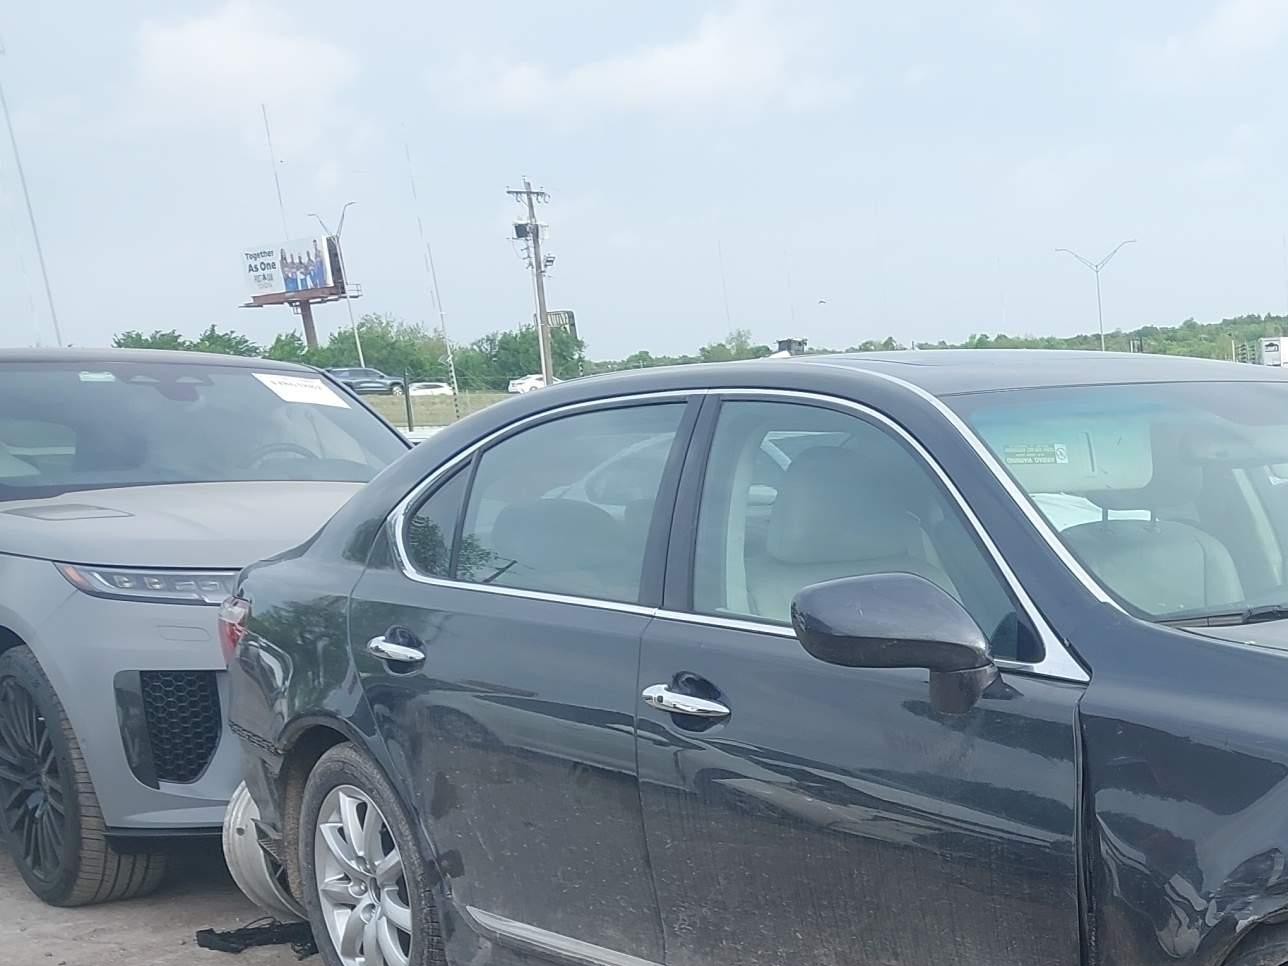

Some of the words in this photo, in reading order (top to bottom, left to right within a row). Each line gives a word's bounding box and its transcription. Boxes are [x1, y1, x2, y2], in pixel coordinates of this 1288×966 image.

[245, 250, 274, 261] Together
[248, 263, 259, 273] As
[260, 261, 277, 271] One
